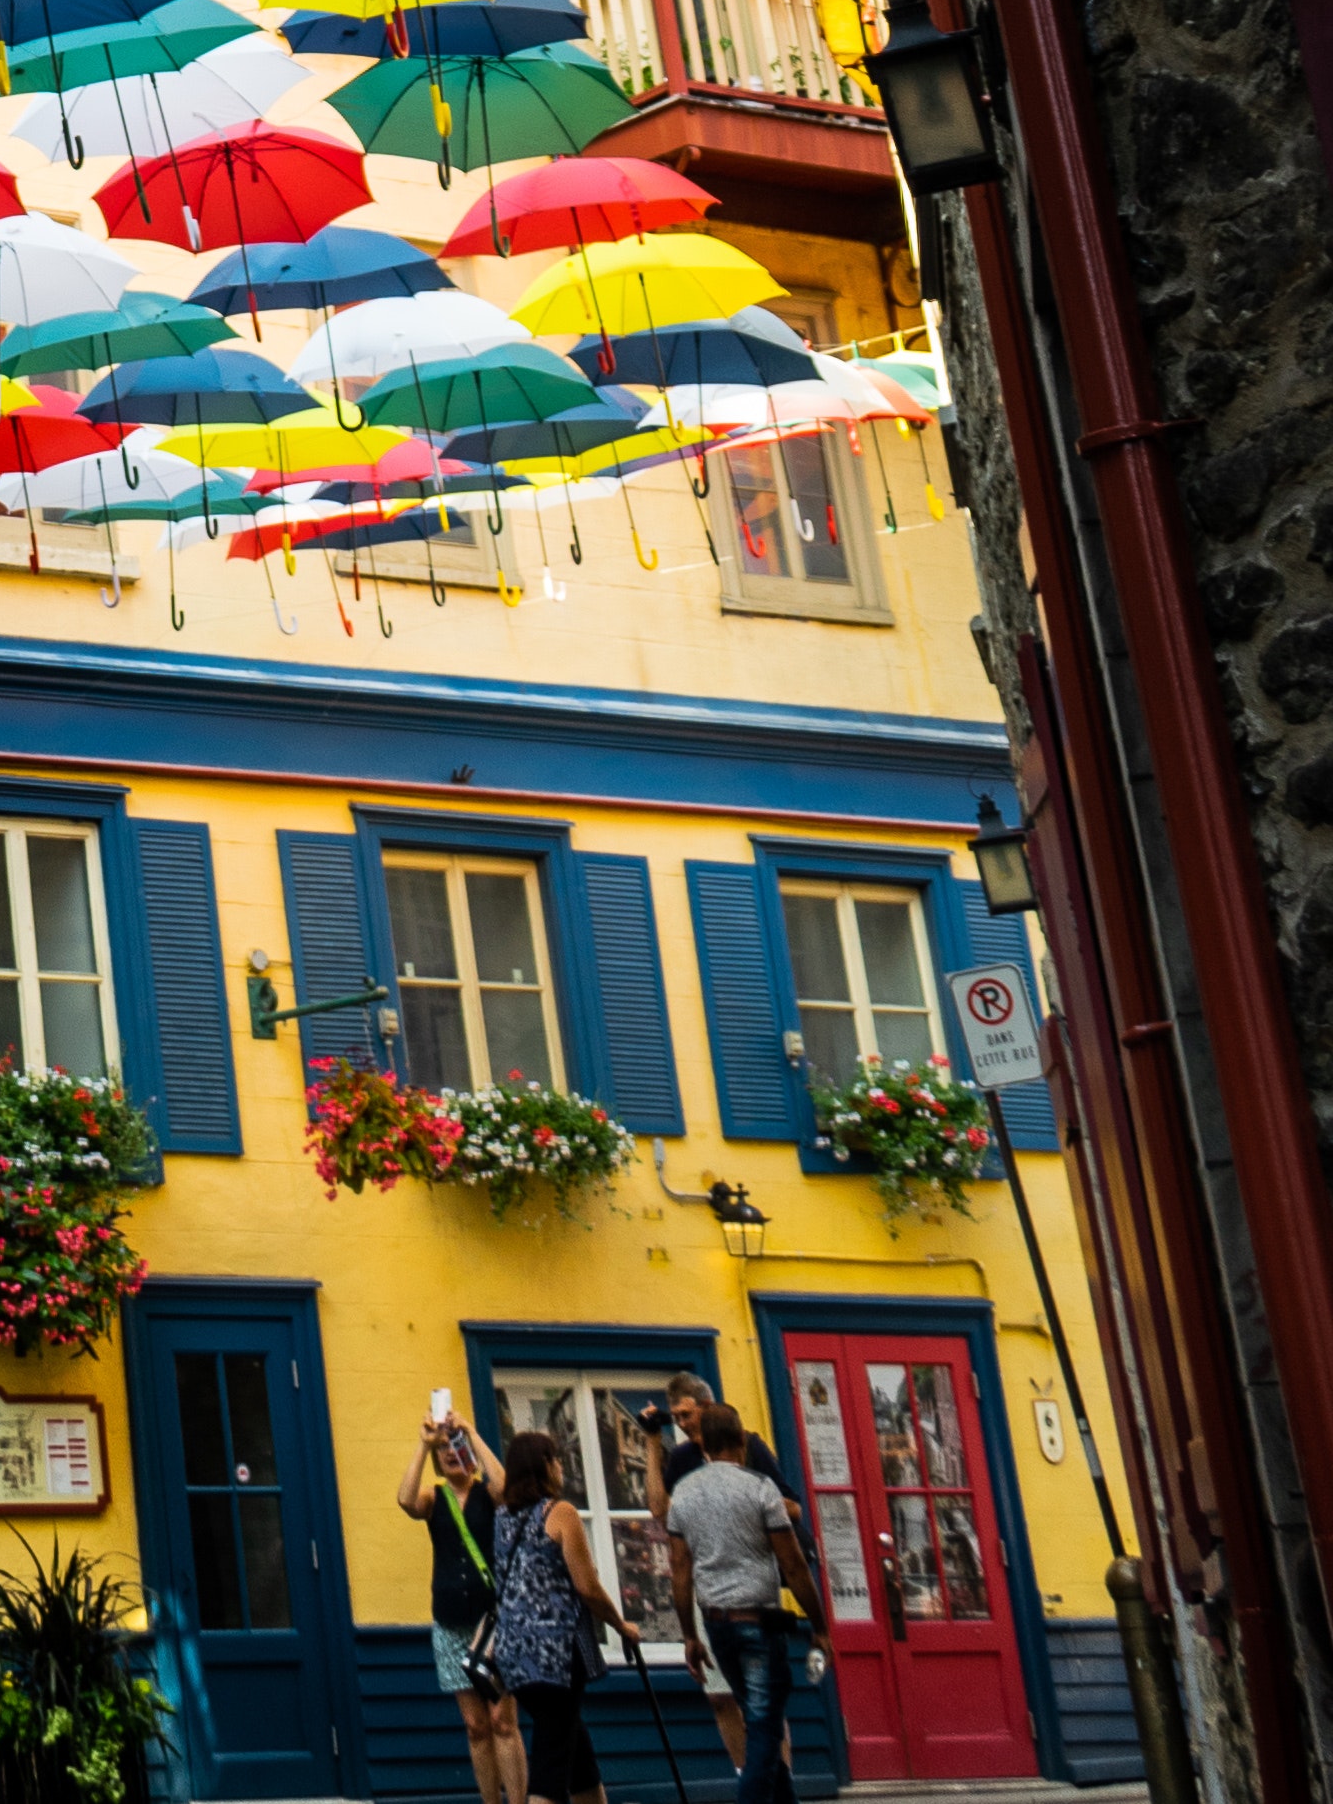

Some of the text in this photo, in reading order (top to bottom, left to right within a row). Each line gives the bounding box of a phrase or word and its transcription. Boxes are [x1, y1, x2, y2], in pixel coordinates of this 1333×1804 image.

[986, 1031, 1015, 1046] DANS
[975, 1046, 1036, 1067] CETTE RUE
